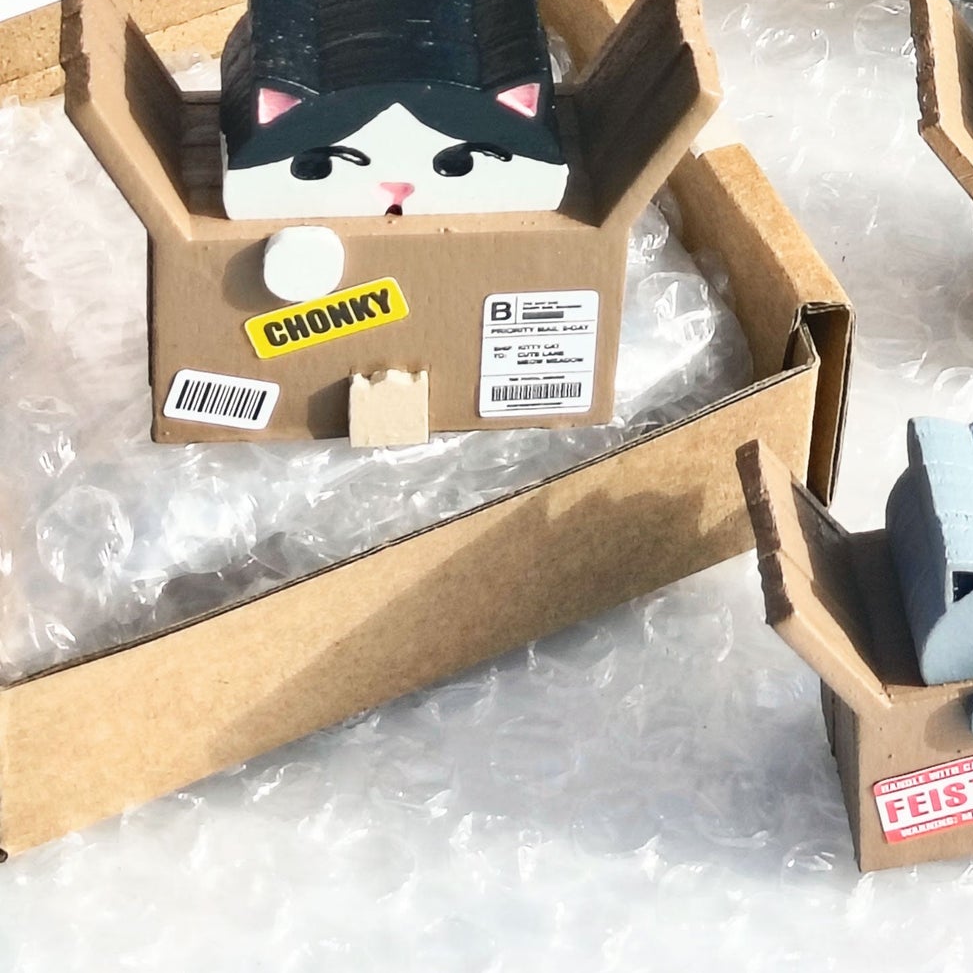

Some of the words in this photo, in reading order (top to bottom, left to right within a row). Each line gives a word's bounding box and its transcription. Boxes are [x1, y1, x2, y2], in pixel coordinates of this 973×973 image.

[263, 288, 391, 348] CHONKY
[491, 302, 512, 321] B
[880, 774, 925, 793] HANDLE
[928, 765, 960, 781] WITH
[900, 817, 958, 837] WARNING:
